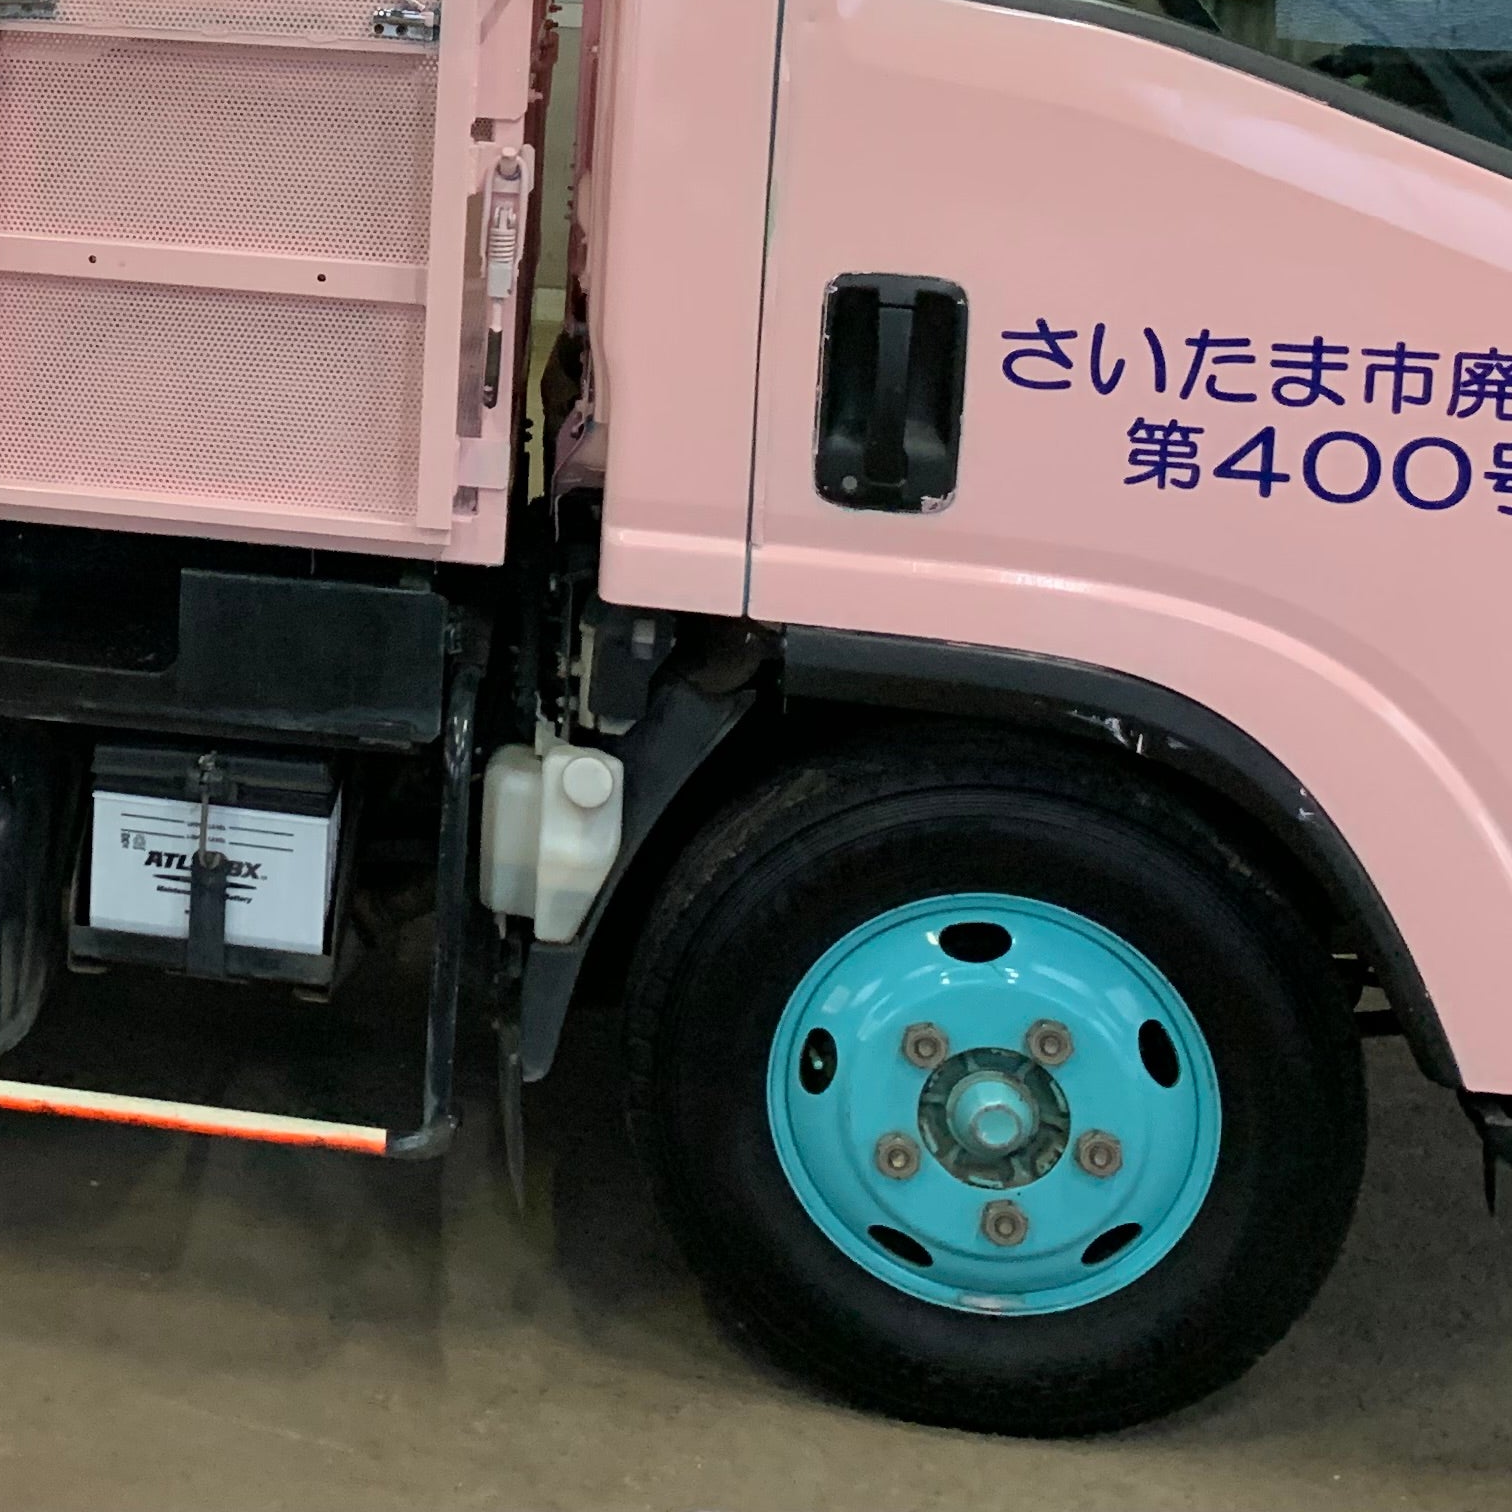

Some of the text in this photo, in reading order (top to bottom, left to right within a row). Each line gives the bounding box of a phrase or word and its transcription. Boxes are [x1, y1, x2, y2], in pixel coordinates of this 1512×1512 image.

[1000, 317, 1512, 420] さいたま市廃
[144, 849, 262, 880] ATLBX
